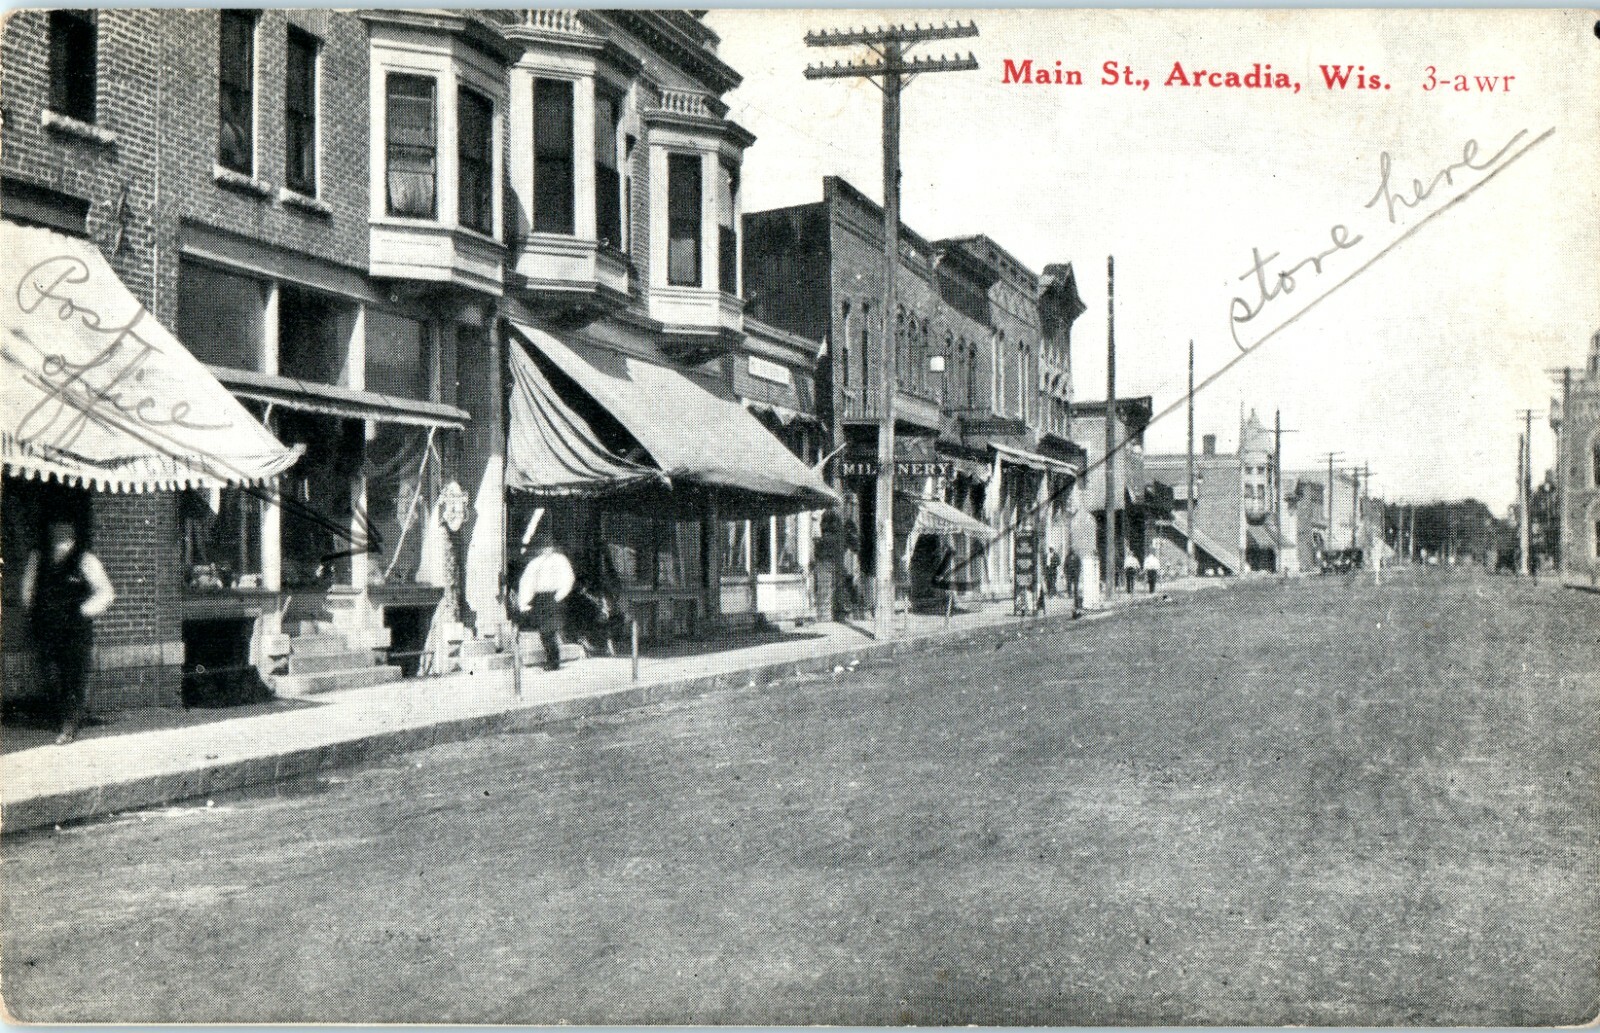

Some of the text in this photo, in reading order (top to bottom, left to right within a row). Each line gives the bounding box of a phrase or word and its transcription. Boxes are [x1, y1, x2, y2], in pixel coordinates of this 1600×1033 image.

[1229, 128, 1529, 354] store here
[16, 254, 165, 355] Post
[842, 462, 950, 476] MILNERY
